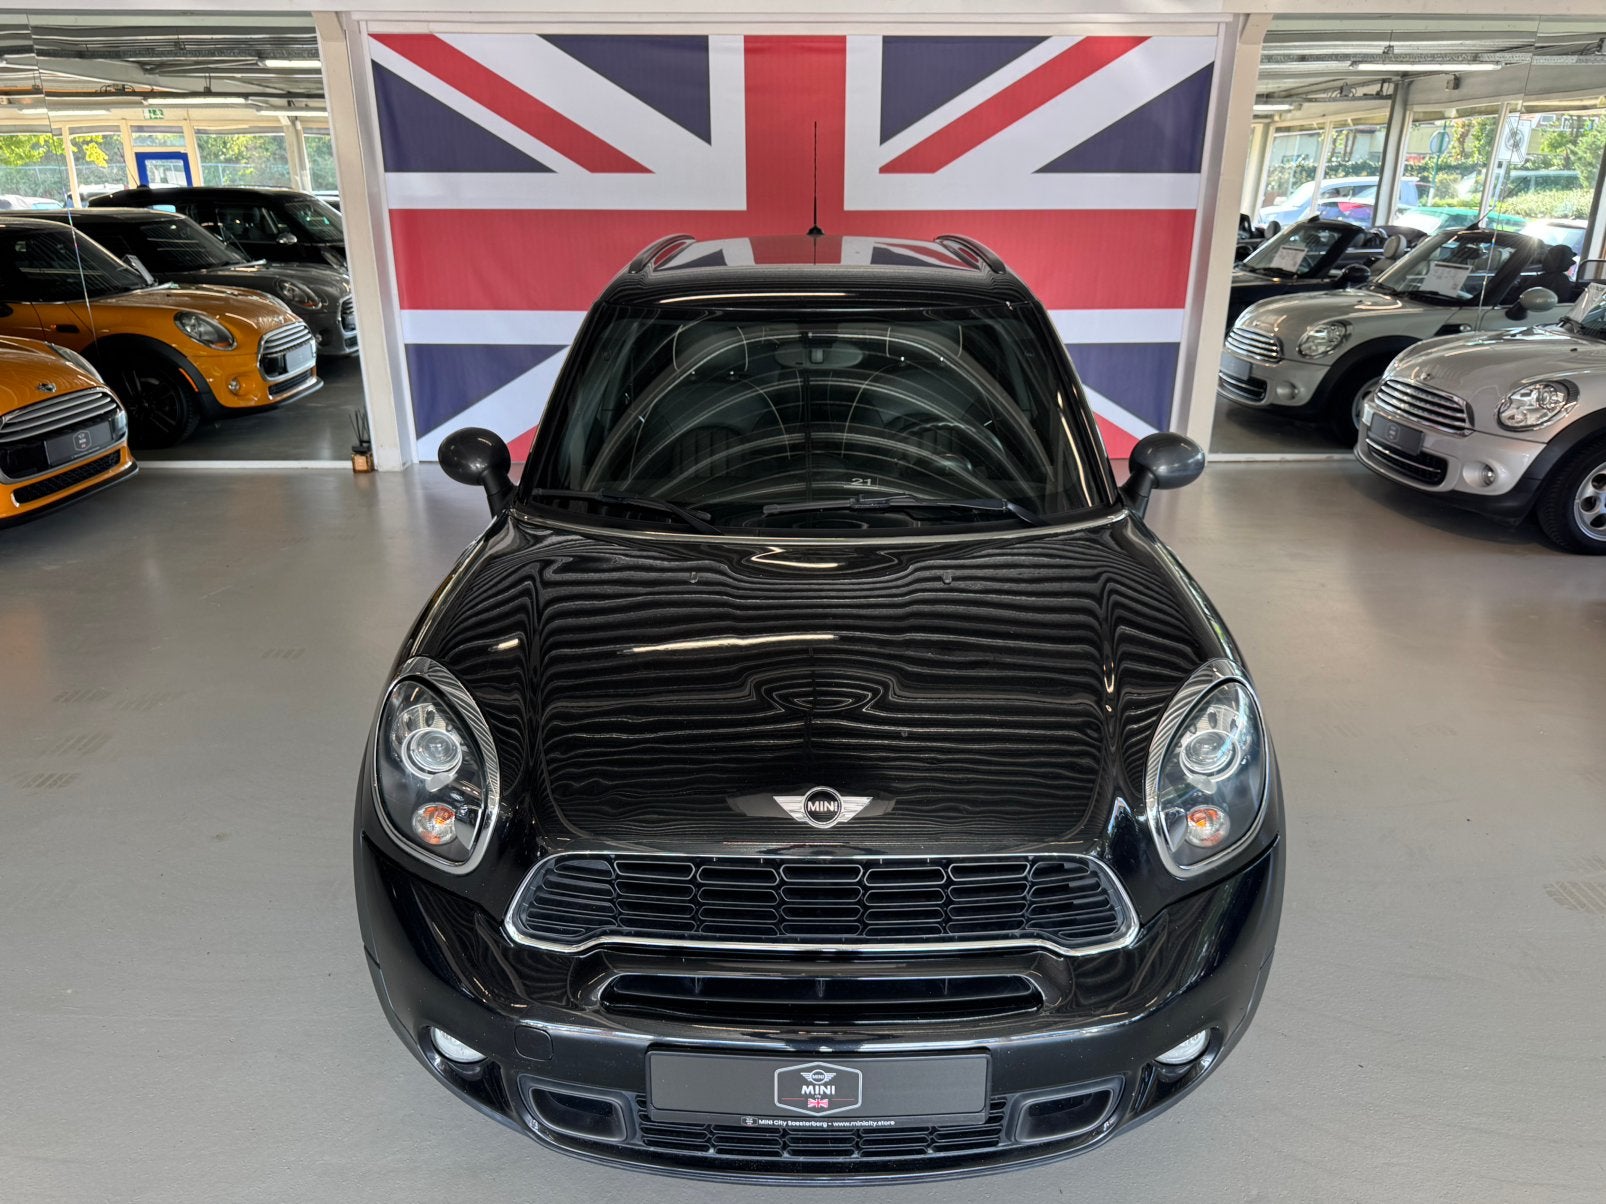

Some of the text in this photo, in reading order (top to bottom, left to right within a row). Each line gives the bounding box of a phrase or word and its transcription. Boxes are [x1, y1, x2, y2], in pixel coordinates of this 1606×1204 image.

[851, 477, 872, 486] 21
[808, 801, 838, 812] MINI
[801, 1085, 836, 1095] MINI
[774, 1119, 787, 1127] City
